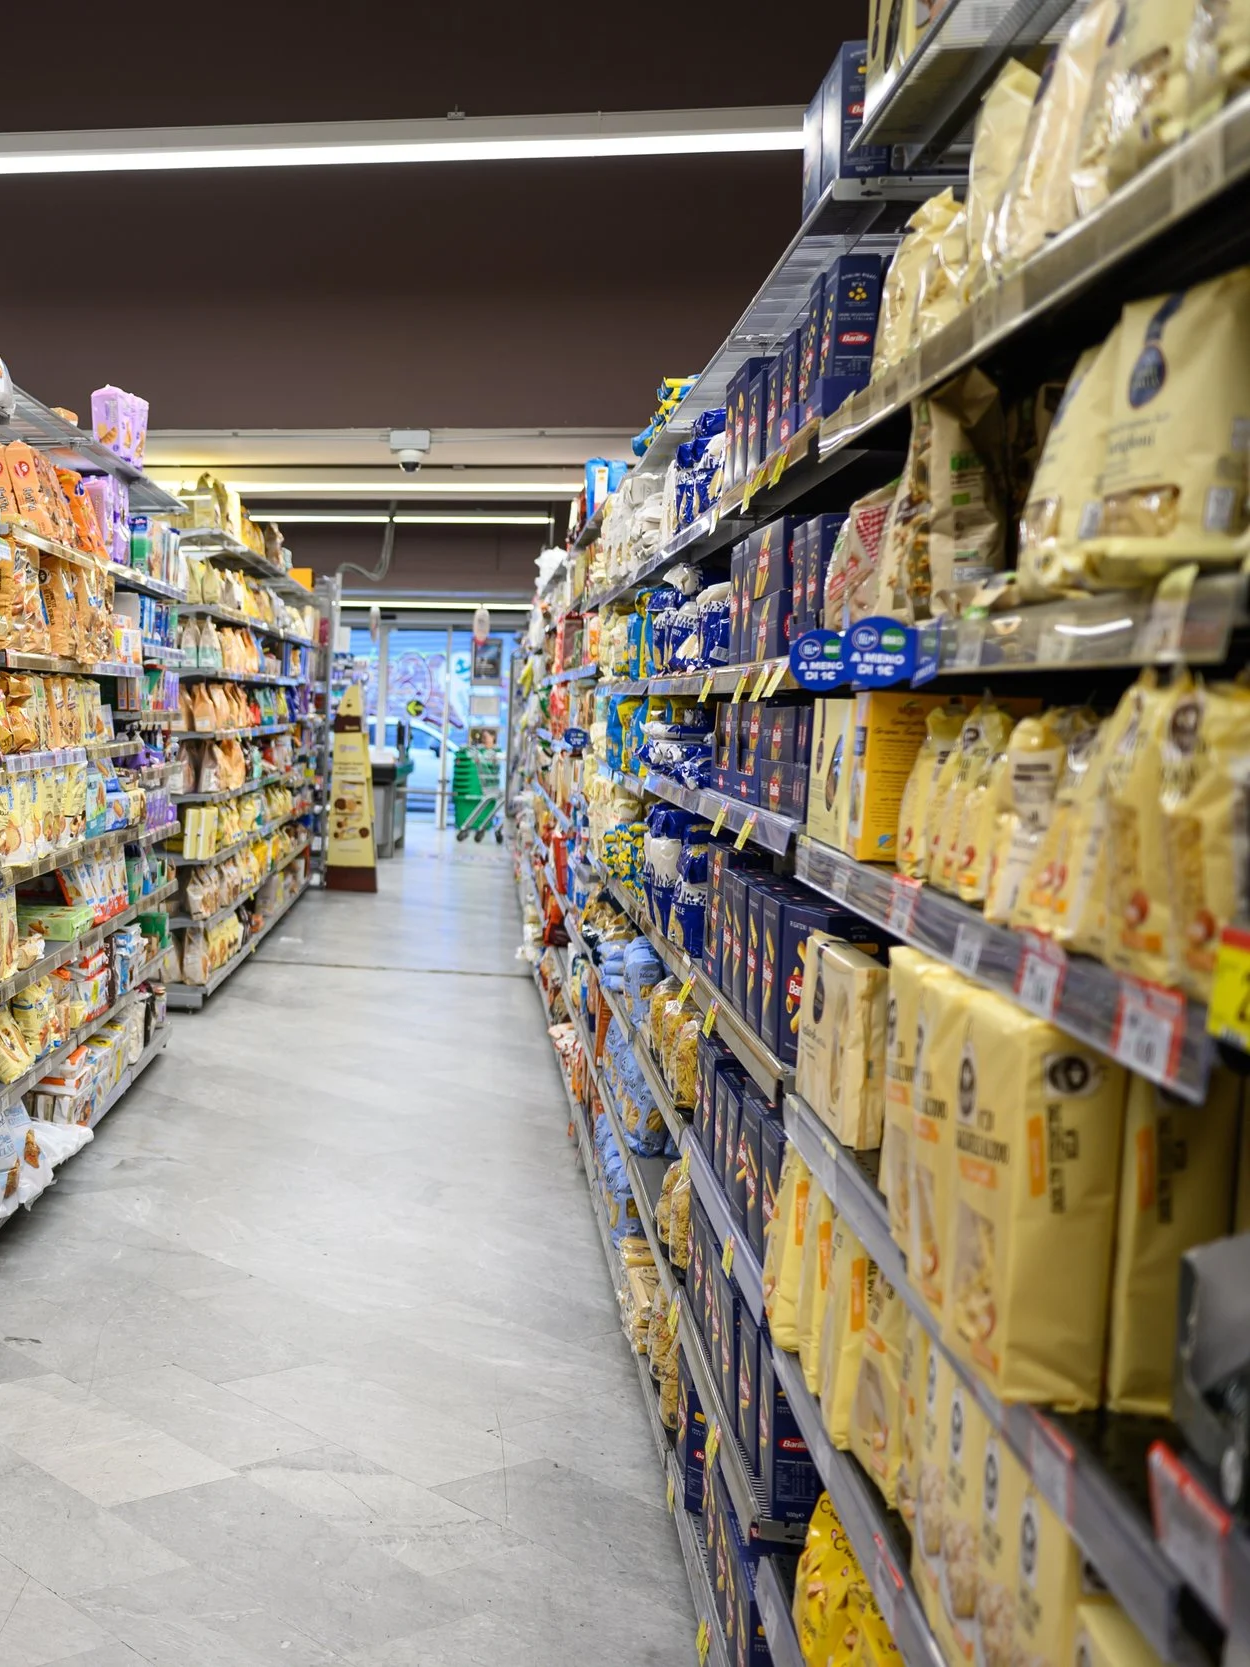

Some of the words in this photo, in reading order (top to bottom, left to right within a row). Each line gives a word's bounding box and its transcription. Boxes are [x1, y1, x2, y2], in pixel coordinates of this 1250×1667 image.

[841, 334, 868, 344] Barilla
[850, 652, 861, 662] A
[863, 652, 906, 665] MENO
[798, 662, 807, 670] A
[809, 661, 844, 671] MENO
[857, 664, 873, 675] DI
[804, 671, 818, 681] DI
